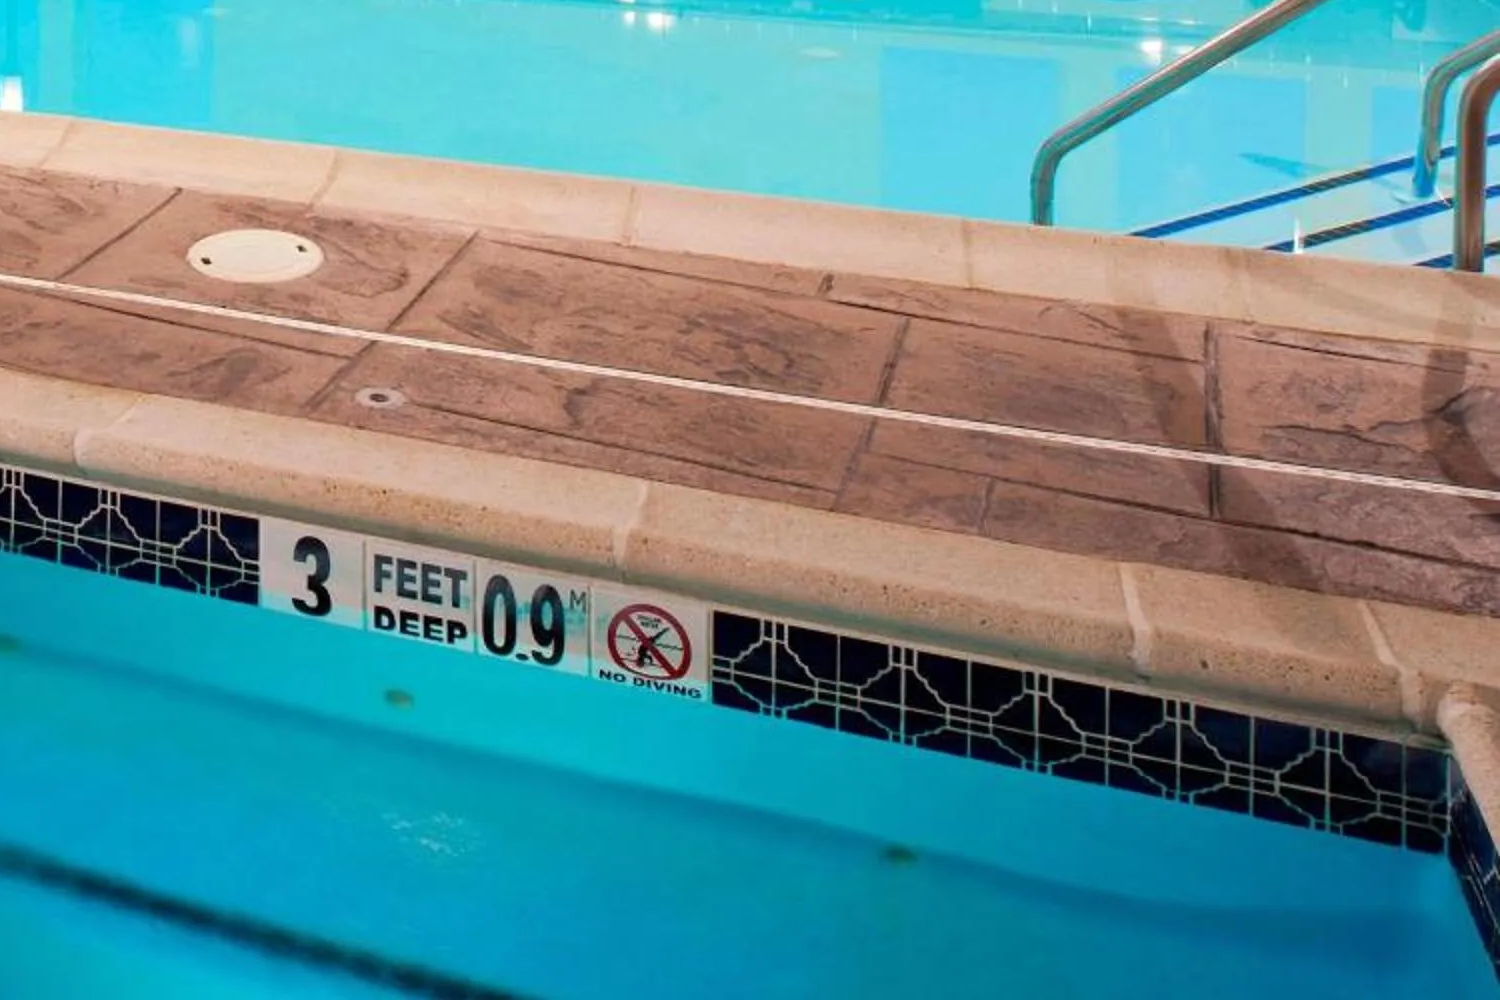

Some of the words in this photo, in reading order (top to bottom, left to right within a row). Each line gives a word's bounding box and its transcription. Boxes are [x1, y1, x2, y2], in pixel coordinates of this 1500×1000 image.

[292, 536, 332, 616] 3
[374, 554, 467, 608] FEET
[374, 606, 467, 644] DEEP
[482, 574, 565, 666] 0.9
[569, 589, 587, 614] M
[599, 669, 626, 683] NO
[633, 677, 702, 699] DIVING
